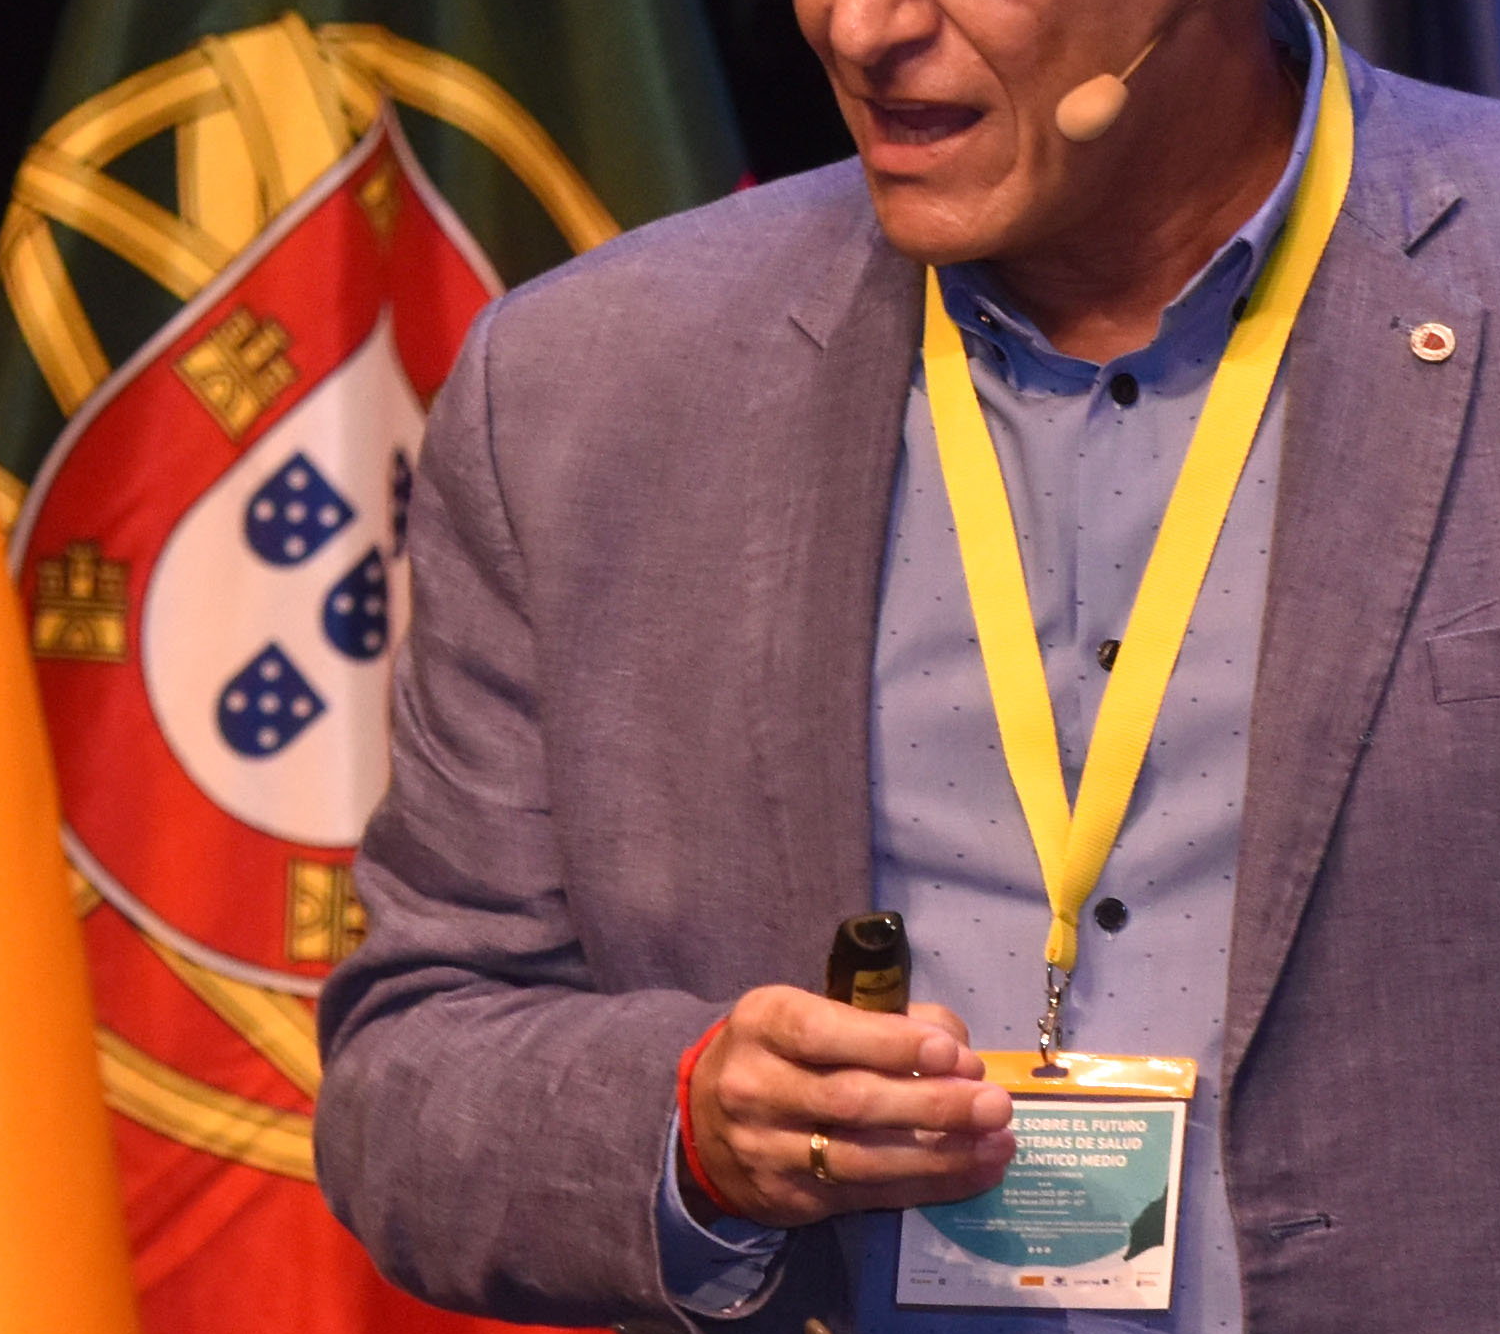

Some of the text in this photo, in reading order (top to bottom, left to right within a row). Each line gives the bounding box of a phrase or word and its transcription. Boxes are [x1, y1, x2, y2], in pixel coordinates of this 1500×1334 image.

[1023, 1118, 1071, 1131] SOBRE
[1072, 1119, 1089, 1132] EL
[1091, 1119, 1148, 1133] FUTURO
[1015, 1136, 1143, 1150] STEMAS DE SALUD
[1010, 1151, 1128, 1167] LÁNTICO MEDIO
